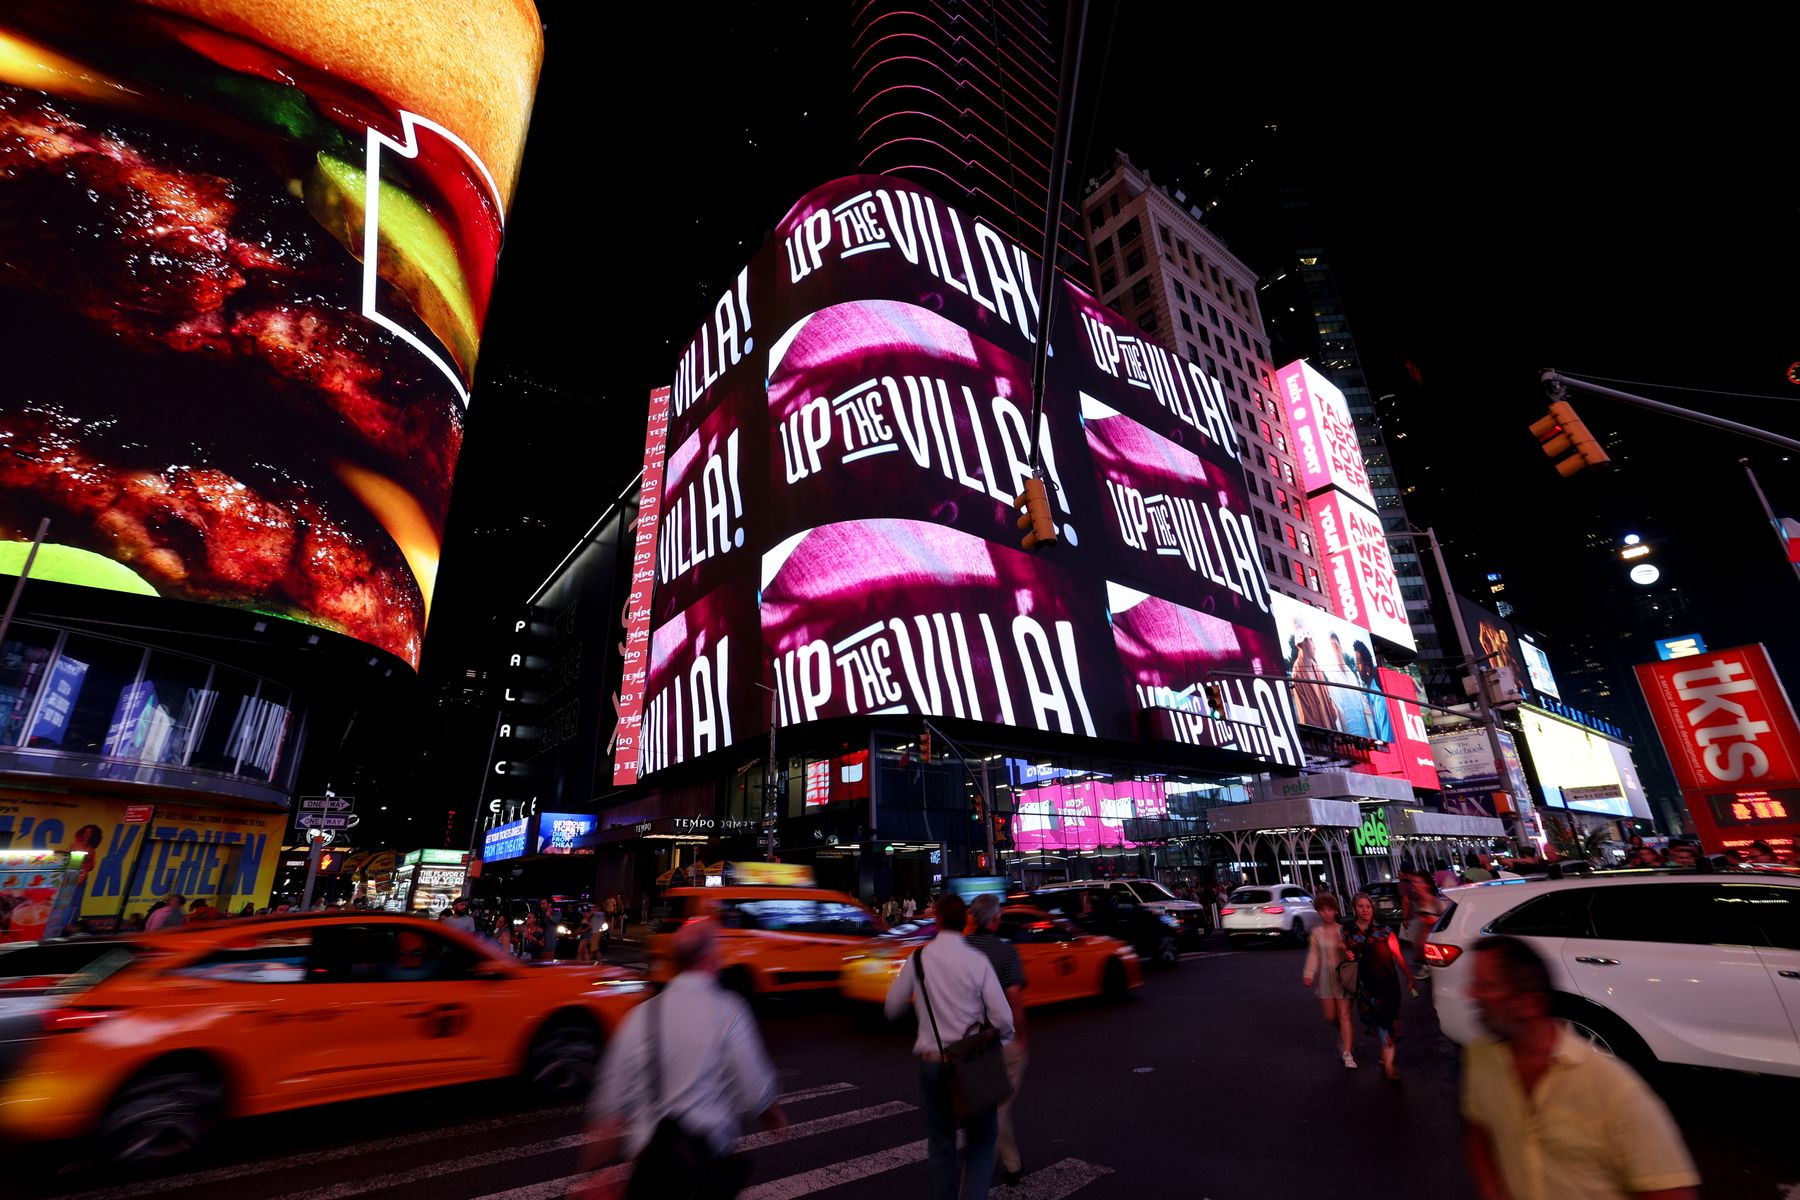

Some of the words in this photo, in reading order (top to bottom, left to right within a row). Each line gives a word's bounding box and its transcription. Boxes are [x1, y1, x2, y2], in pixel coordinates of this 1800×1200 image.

[785, 208, 832, 283] UP
[835, 201, 886, 248] THE
[876, 189, 1054, 357] VILLA!
[674, 265, 754, 417] VILLA!
[1081, 312, 1120, 377] UP
[1119, 343, 1147, 381] THE
[1136, 338, 1243, 464] VILLA!
[660, 428, 745, 584] VILLA!
[780, 397, 832, 484] UP
[835, 391, 893, 451] THE
[881, 376, 1078, 547] VILLA!
[1106, 480, 1148, 550] UP
[1147, 504, 1177, 546] THE
[1164, 495, 1275, 615] VILLA!
[1360, 561, 1394, 595] PAY
[1367, 587, 1407, 624] YOU
[490, 620, 526, 812] PALACE
[774, 639, 832, 728] UP
[836, 637, 902, 714] THE
[1672, 659, 1771, 782] tkts
[674, 813, 715, 833] TEMPO
[1282, 777, 1310, 796] pelé
[1354, 806, 1390, 855] pelé
[91, 823, 268, 897] KITCHEN
